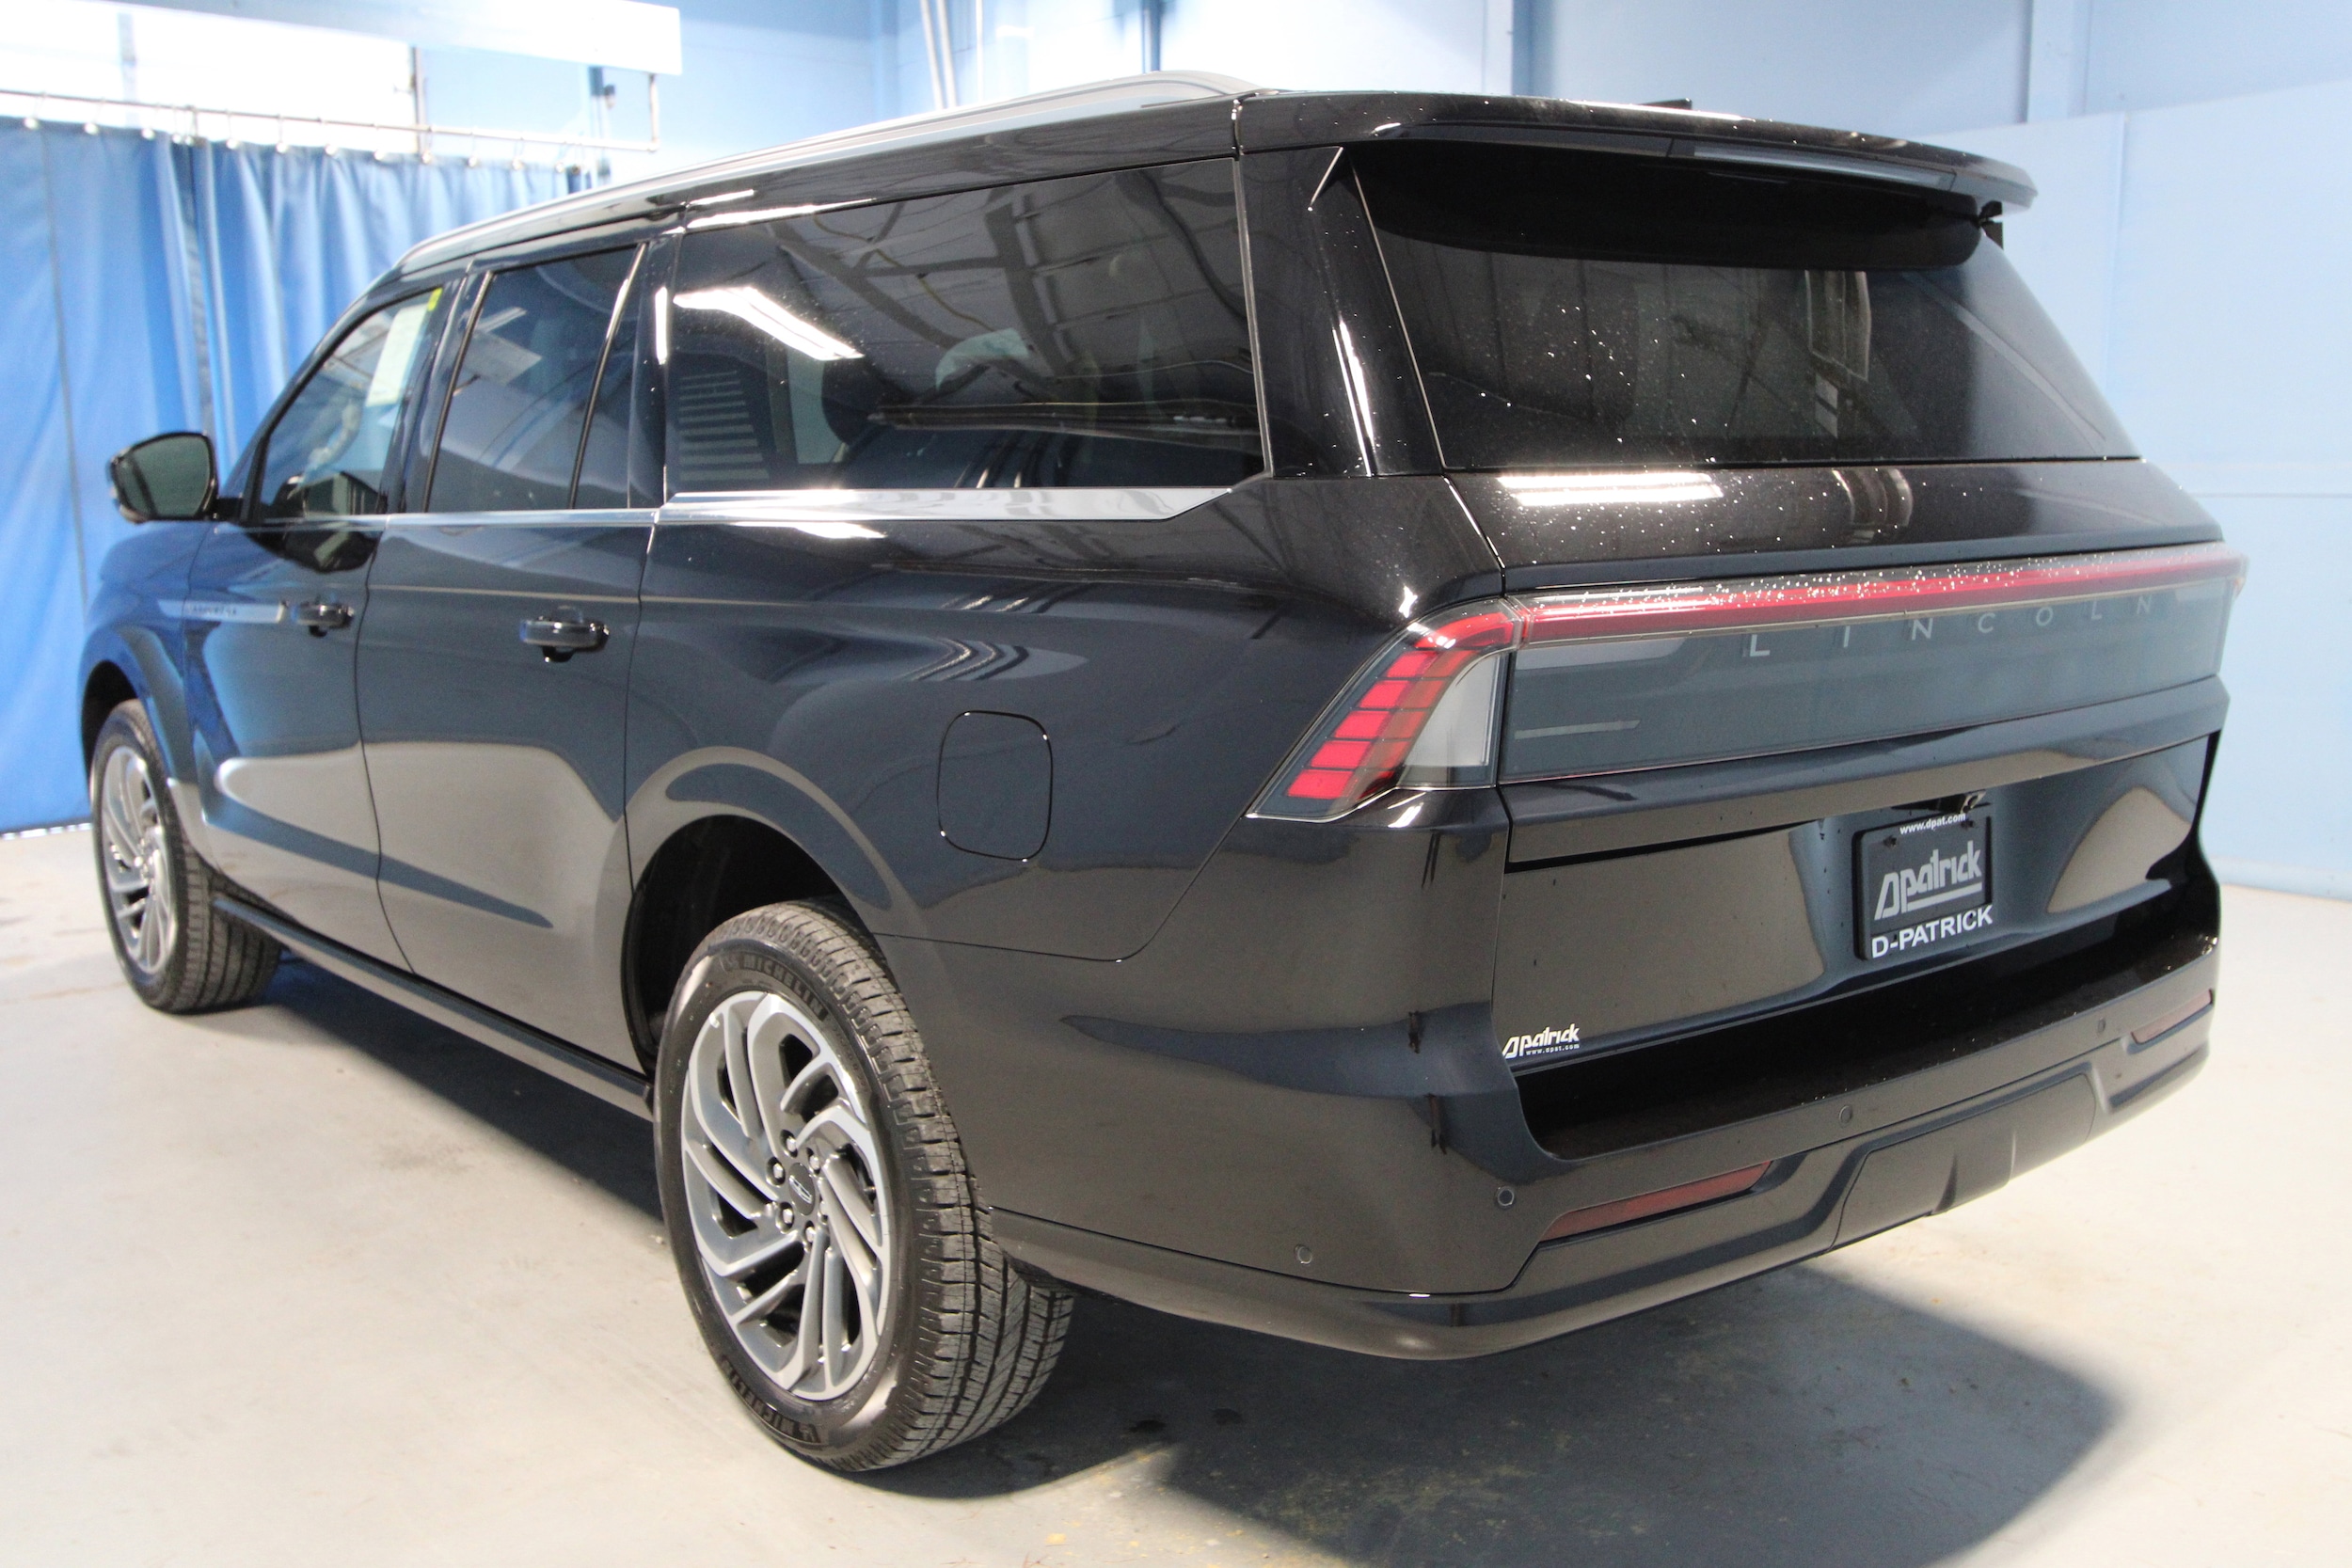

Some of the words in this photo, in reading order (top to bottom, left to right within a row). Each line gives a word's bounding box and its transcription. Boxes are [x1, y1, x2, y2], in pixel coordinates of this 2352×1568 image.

[1749, 595, 2153, 657] LINCOLN
[1899, 813, 1966, 834] www.dpat.com
[1871, 905, 1994, 958] D-PATRICK
[742, 954, 827, 1020] MICHELIN
[1525, 1043, 1581, 1056] www.dpat.com
